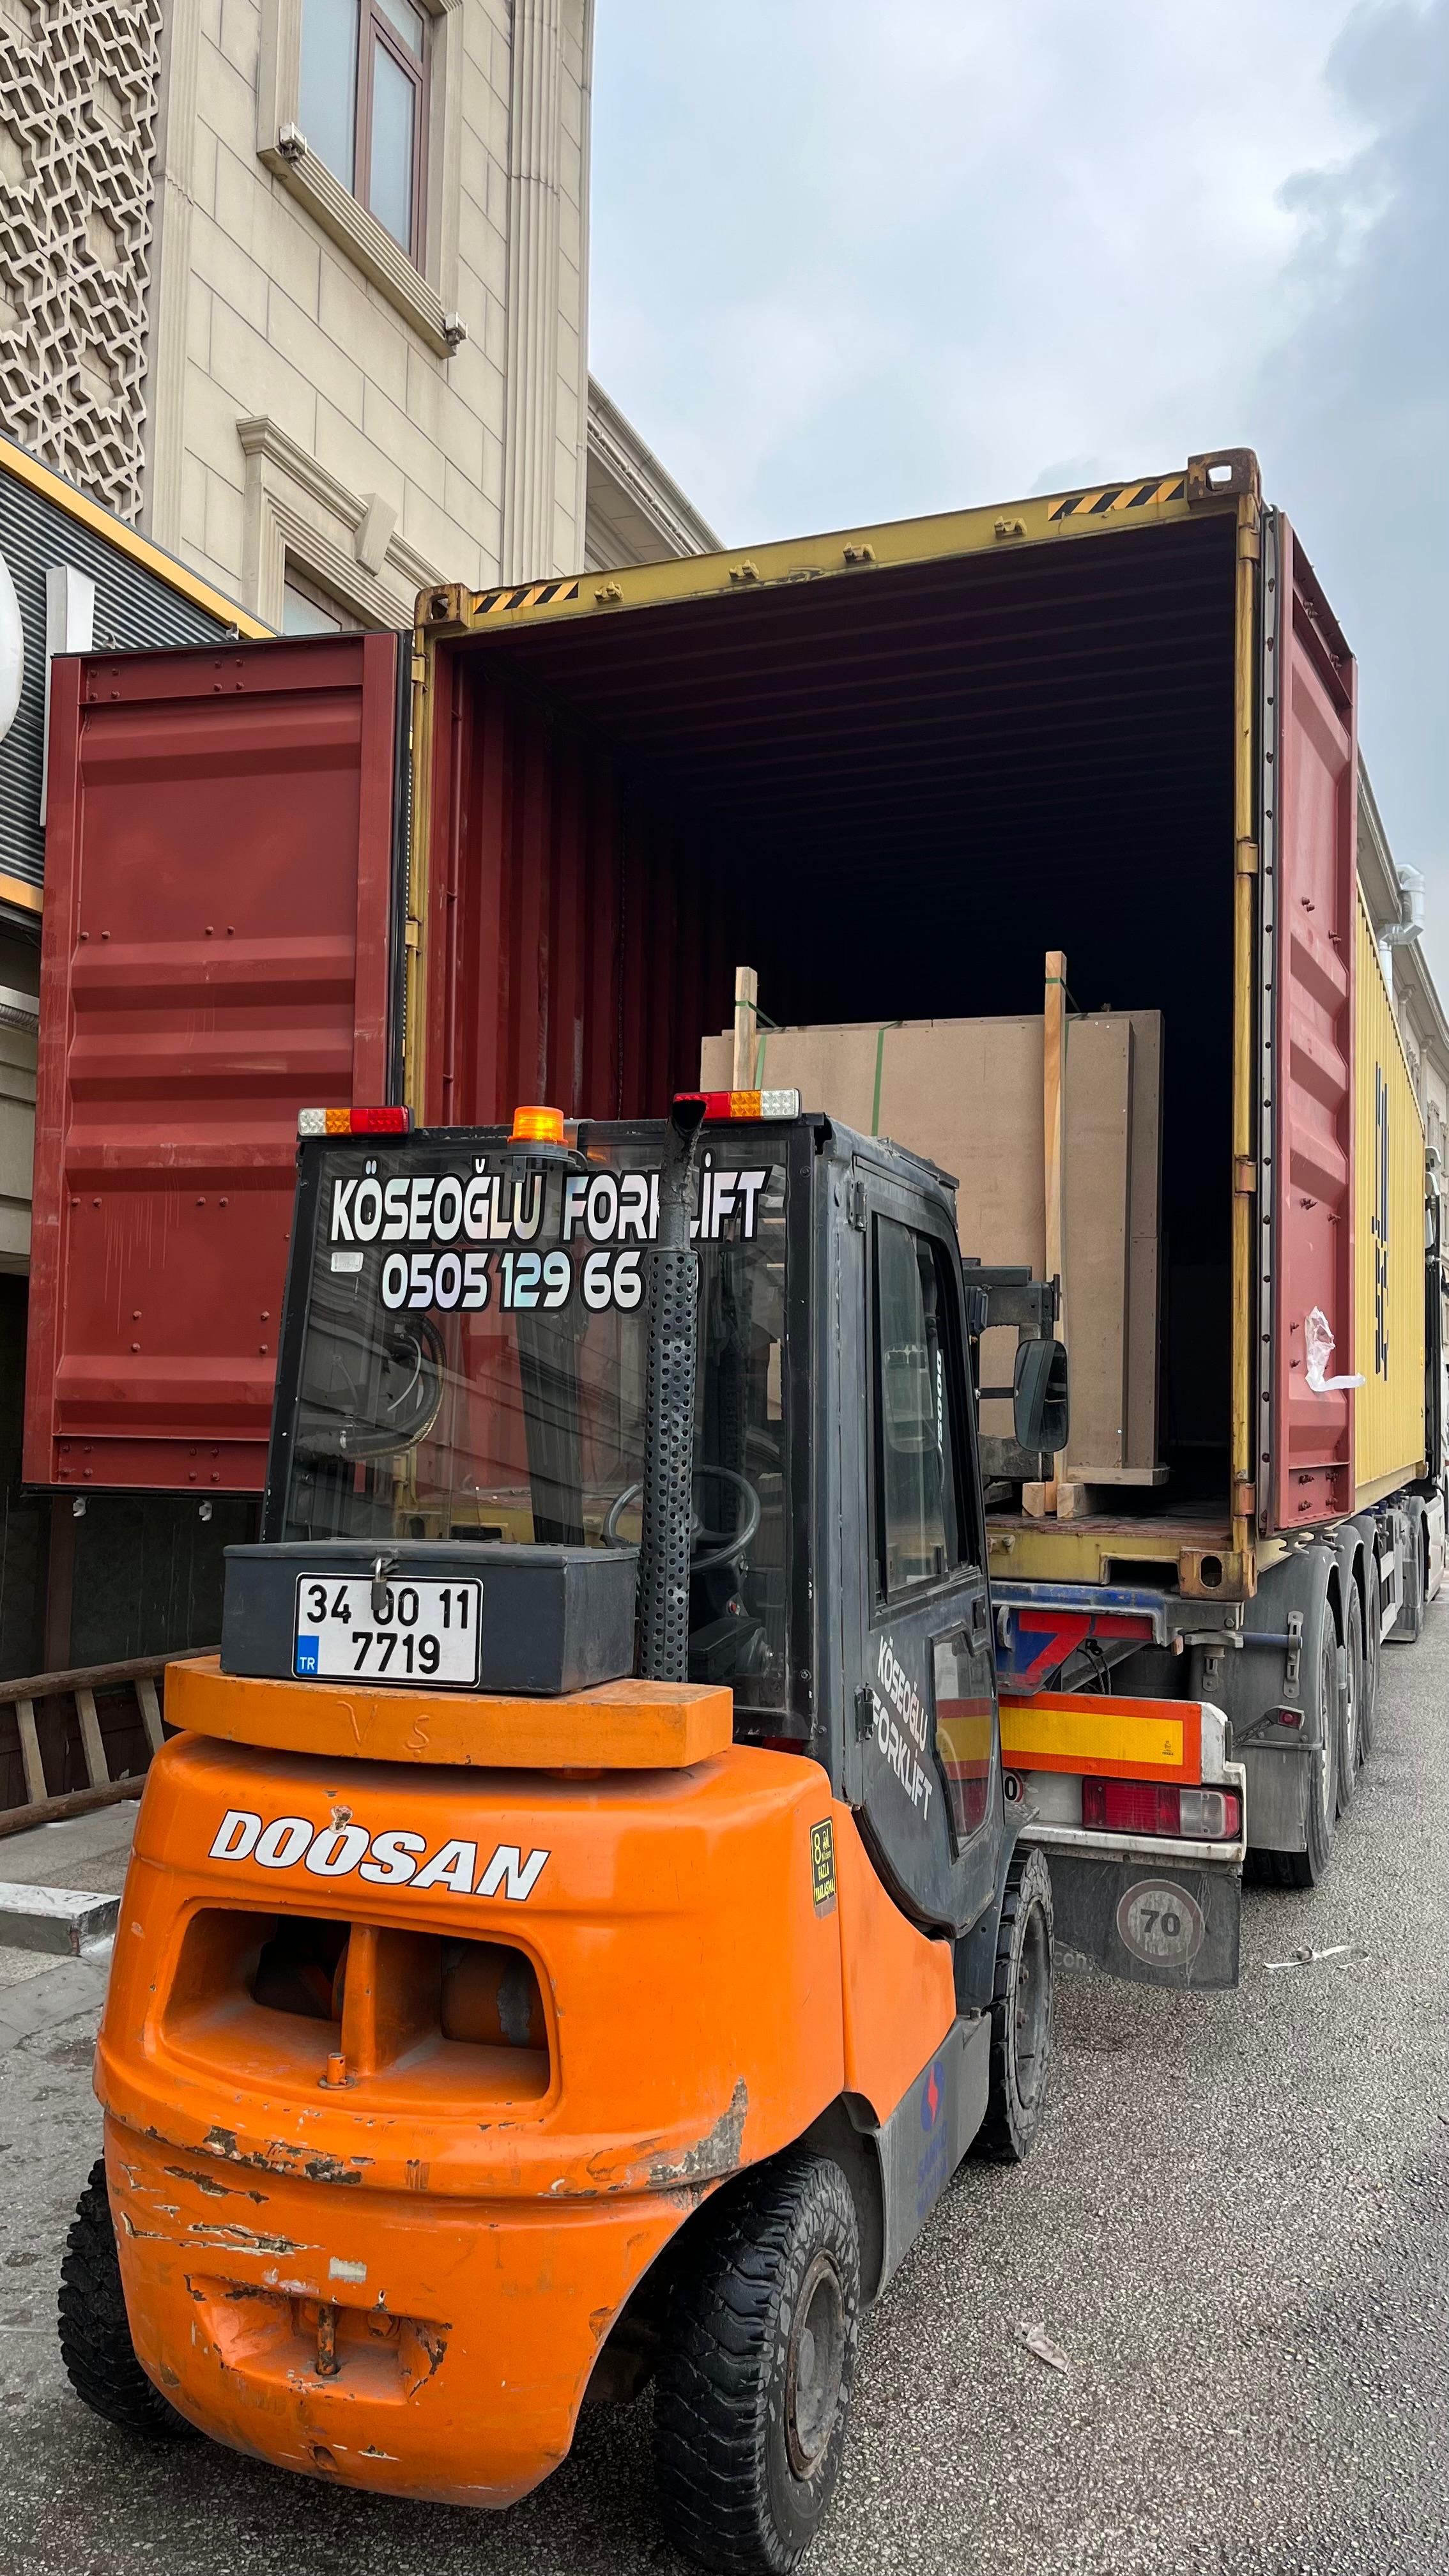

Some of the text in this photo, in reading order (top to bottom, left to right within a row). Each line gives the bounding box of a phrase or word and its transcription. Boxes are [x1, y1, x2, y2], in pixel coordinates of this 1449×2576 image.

[331, 1152, 767, 1241] KÖSEOĞLU FORİFT
[382, 1252, 489, 1308] 0505
[501, 1250, 571, 1308] 129
[307, 1584, 352, 1624] 34
[439, 1588, 470, 1629] 11
[300, 1657, 315, 1671] TR
[352, 1630, 441, 1675] 7719
[877, 1635, 928, 1752] KÖSEOĞLU
[873, 1689, 933, 1821] FORKLİFT
[1004, 1775, 1018, 1801] 0
[208, 1809, 552, 1902] DOOSAN
[815, 1833, 821, 1864] 8
[1140, 1908, 1181, 1936] 70
